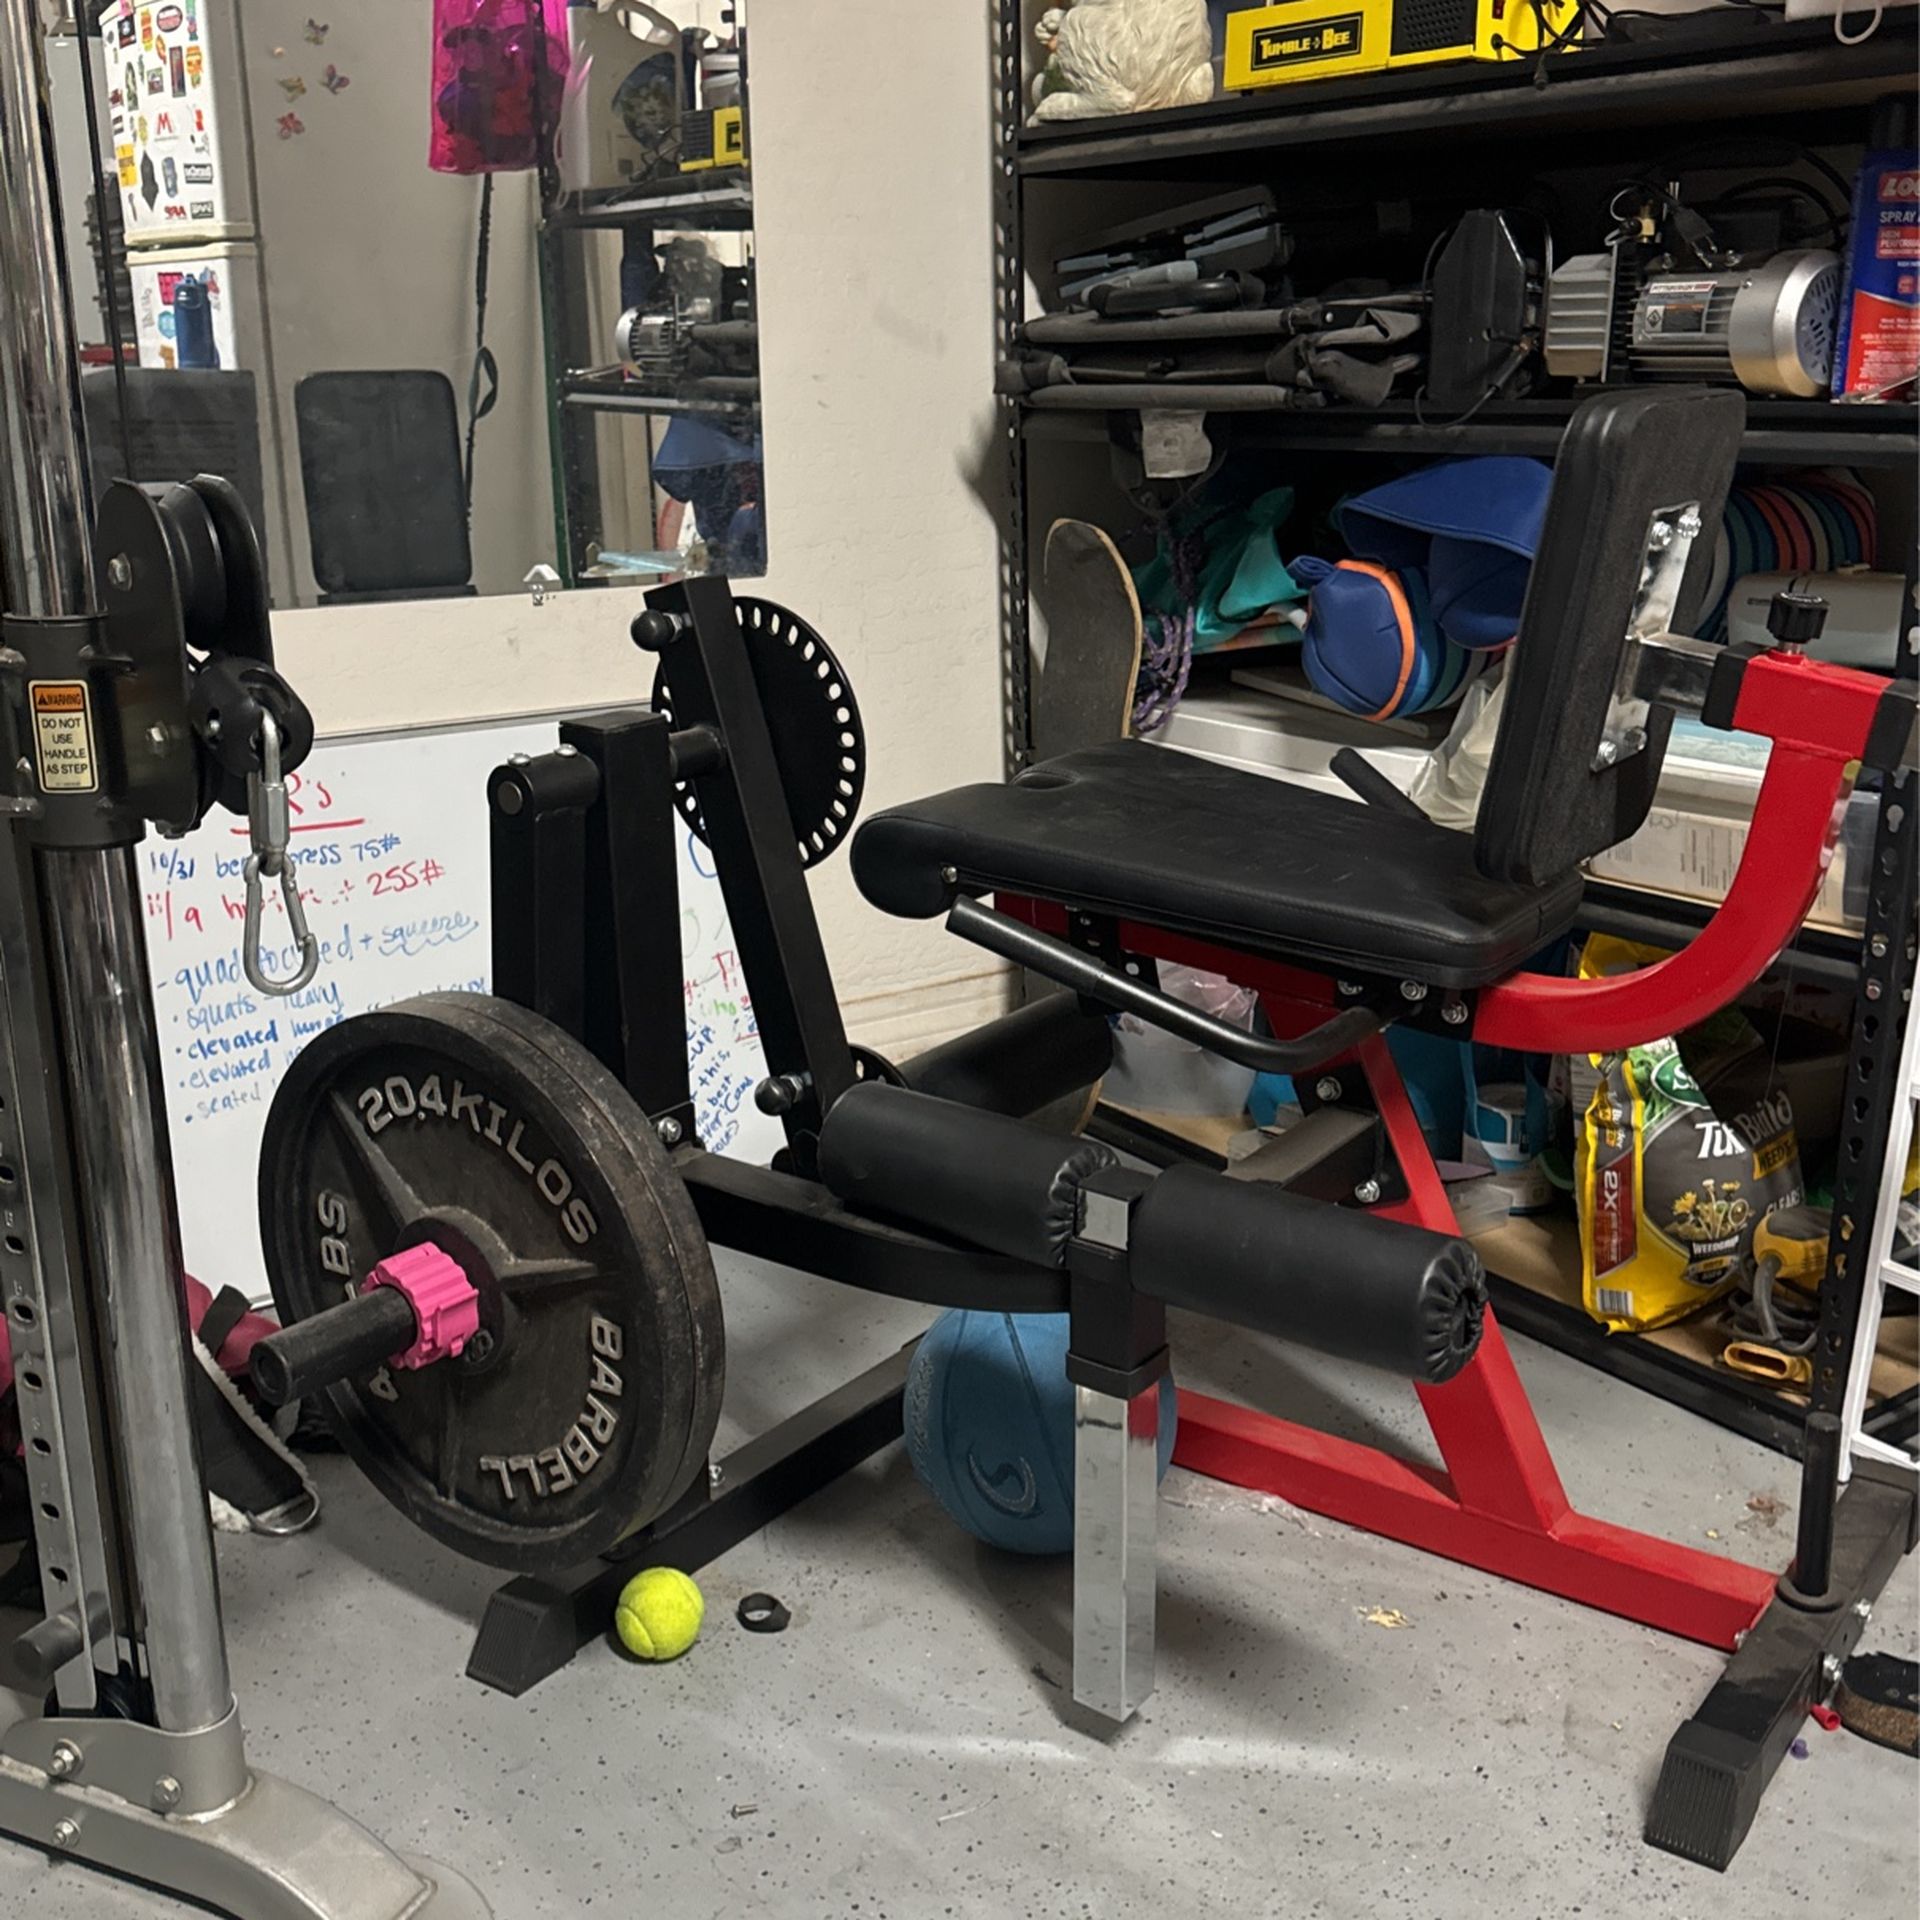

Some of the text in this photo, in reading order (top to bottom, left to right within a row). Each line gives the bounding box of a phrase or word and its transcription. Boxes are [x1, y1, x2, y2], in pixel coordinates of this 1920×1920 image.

[1322, 28, 1350, 50] BEE
[1879, 210, 1917, 223] SPRAY
[41, 717, 82, 729] DO NOT
[51, 733, 74, 744] USE
[44, 748, 87, 759] HANDLE
[46, 763, 88, 774] AS STEP
[175, 947, 242, 1005] quad
[186, 992, 258, 1034] squats
[187, 1019, 279, 1060] elevated
[189, 1048, 271, 1089] elevated
[479, 1315, 624, 1500] BARBELL
